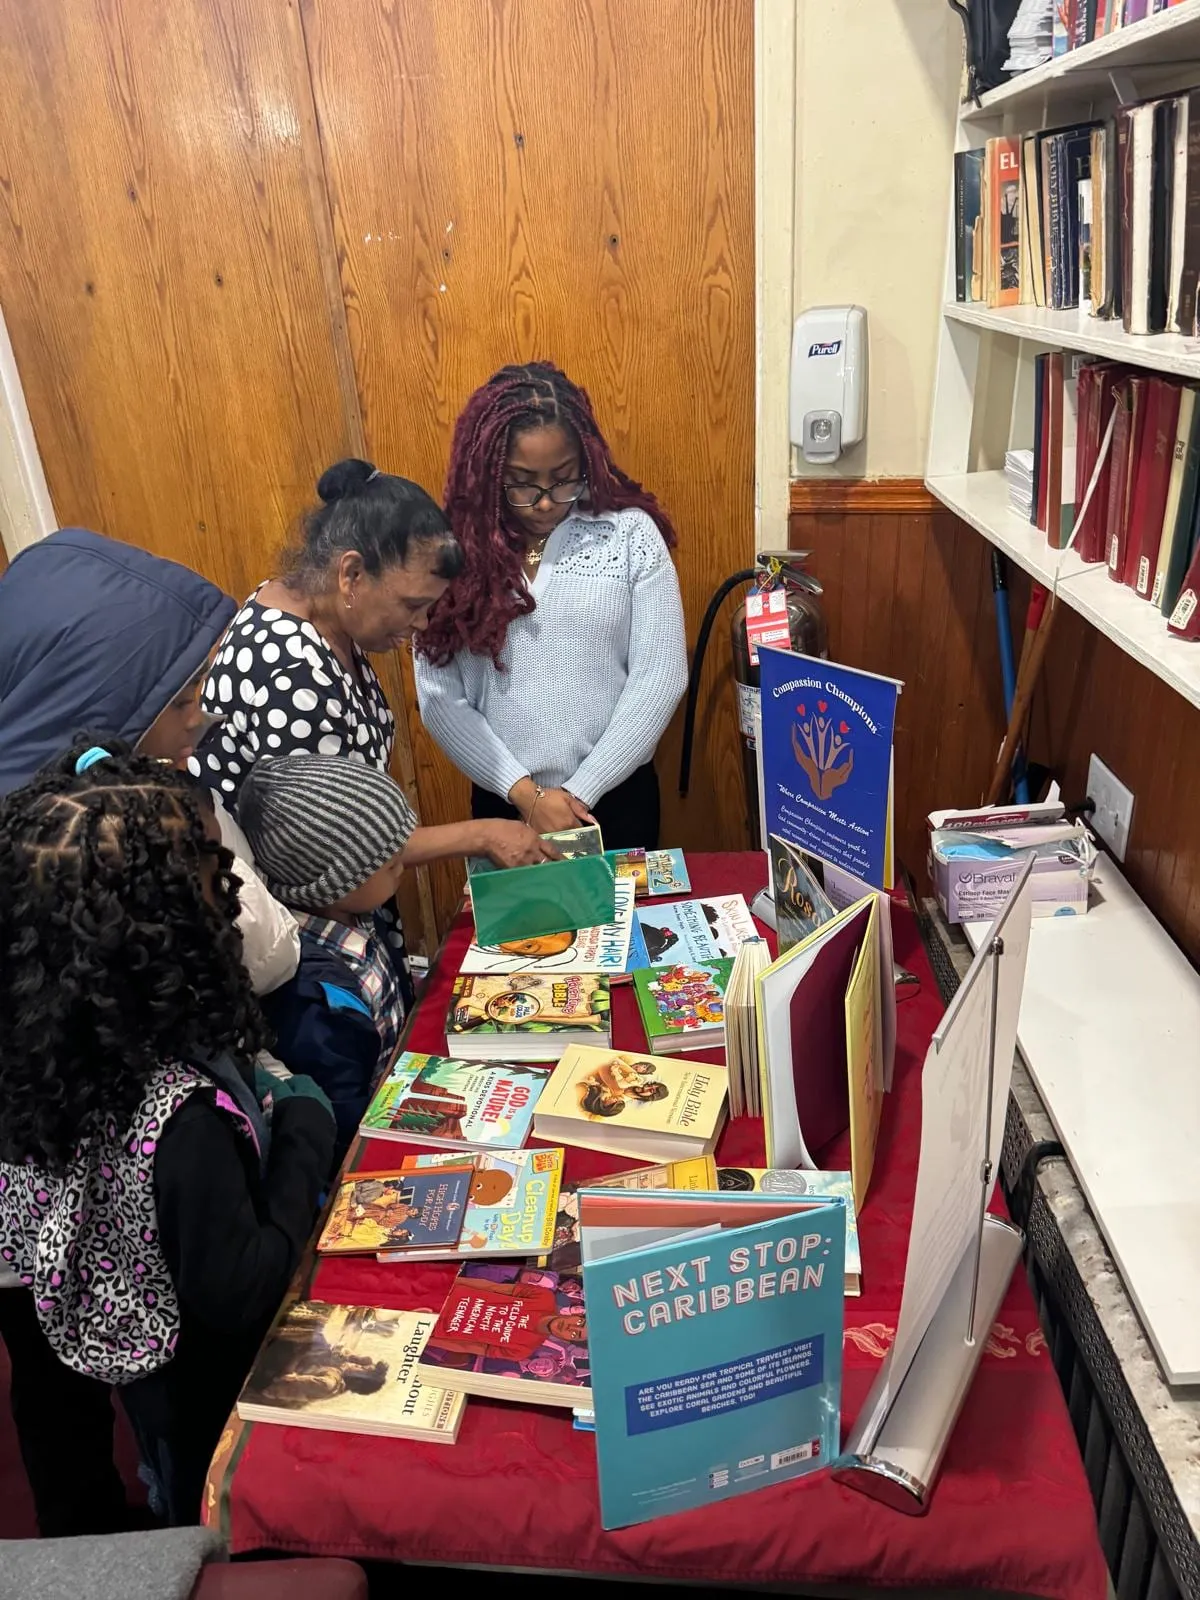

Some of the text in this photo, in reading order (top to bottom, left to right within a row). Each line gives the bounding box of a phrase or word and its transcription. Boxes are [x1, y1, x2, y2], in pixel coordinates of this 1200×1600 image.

[812, 343, 838, 355] Purell
[772, 677, 878, 734] Compassion Champions
[795, 793, 827, 816] Compassion
[828, 810, 847, 826] Meets
[603, 921, 626, 937] MY
[681, 901, 703, 933] SOMETHING
[693, 934, 715, 960] BEAUTIF
[596, 940, 626, 967] HAIR!
[552, 982, 568, 1008] BIBLE
[562, 975, 584, 1015] Adventure
[480, 1079, 514, 1123] NATURE!
[483, 1076, 495, 1089] KIDS
[508, 1086, 531, 1108] GOD
[679, 1073, 711, 1127] Holy Bible
[465, 1090, 488, 1128] DEVOTIONAL
[517, 1179, 546, 1243] Cleanup
[612, 1233, 832, 1309] NEXT STOP:
[447, 1296, 471, 1333] TEENAGER
[462, 1298, 486, 1335] AMERICAN
[479, 1305, 497, 1331] NORTH
[491, 1305, 509, 1333] TO THE
[623, 1263, 825, 1335] CARIBBEAN
[500, 1300, 524, 1343] FIELD GUIDE
[517, 1315, 530, 1329] THE
[397, 1320, 432, 1384] Laughter
[639, 1342, 812, 1395] ARE YOU READY FOR TROPICAL TRAVELS? VISIT
[402, 1374, 424, 1416] hout
[638, 1350, 814, 1404] THE CARIBBEAN SEA AND SOME OF ITS ISLANDS.
[640, 1359, 811, 1412] SEE EXOTIC ANIMALS AND COLORFUL FLOWERS.
[650, 1370, 803, 1418] EXPLORE CORAL GARDENS AND BEAUTIFUL
[740, 1392, 756, 1403] TOO!
